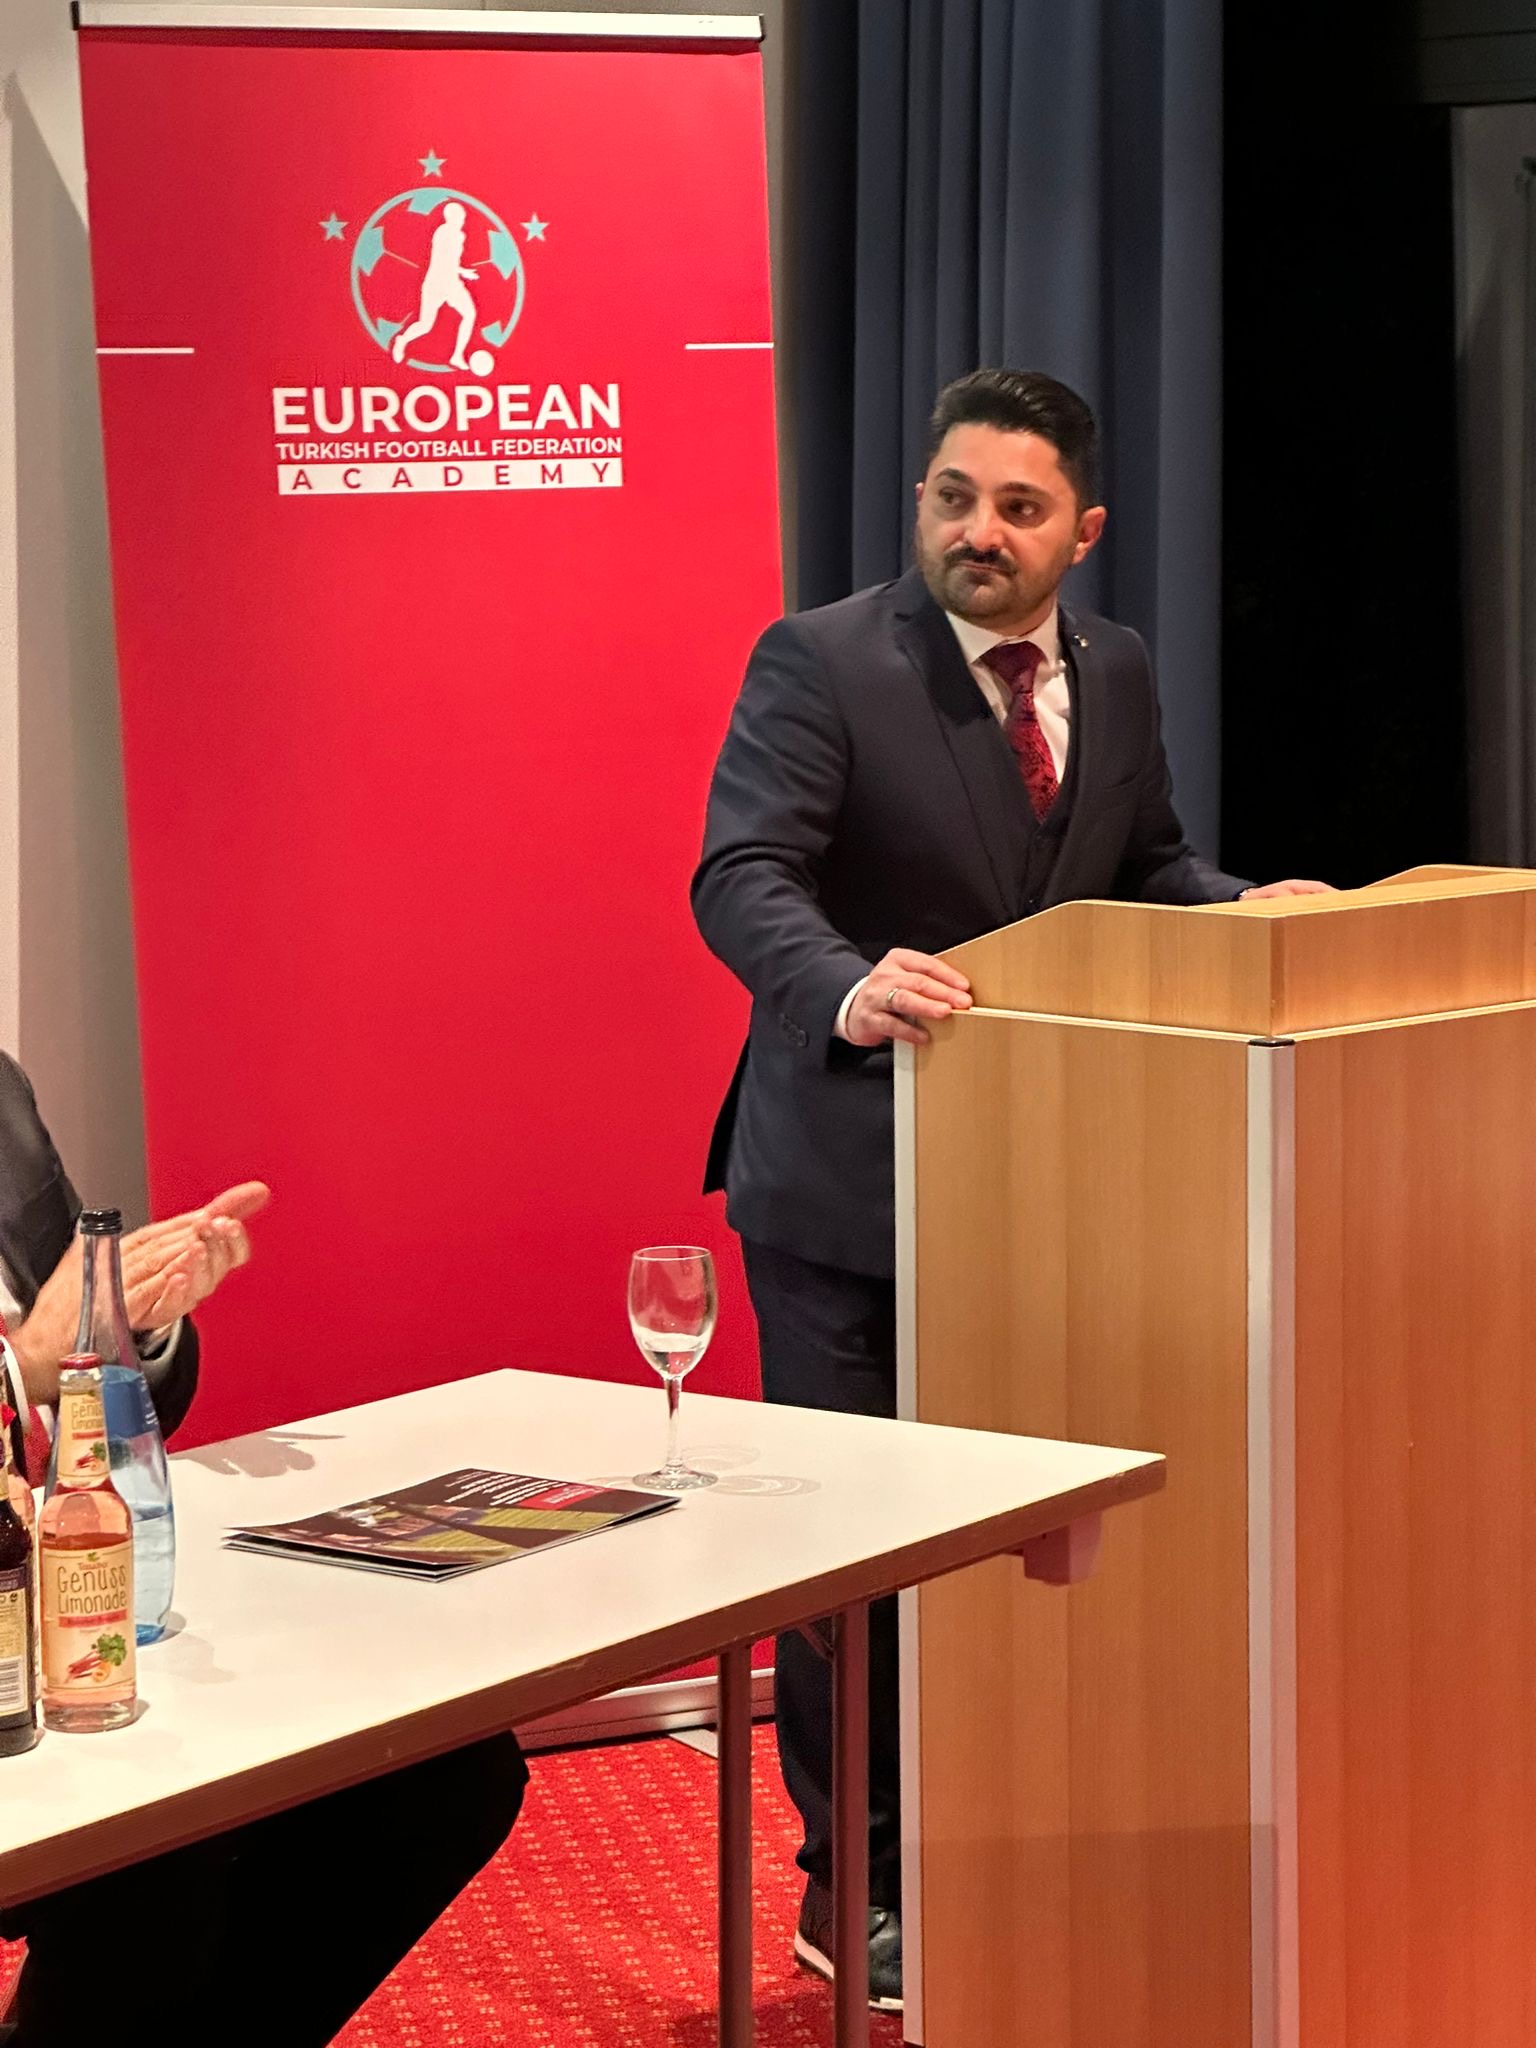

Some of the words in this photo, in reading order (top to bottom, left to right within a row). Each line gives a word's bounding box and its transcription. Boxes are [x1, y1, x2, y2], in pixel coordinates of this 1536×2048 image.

[272, 382, 621, 434] EUROPEAN
[275, 441, 370, 460] TURKISH
[374, 439, 487, 458] FOOTBALL
[491, 436, 622, 456] FEDERATION
[291, 461, 610, 490] ACADEMY
[57, 1564, 127, 1593] Genuss
[57, 1588, 128, 1614] Limonade
